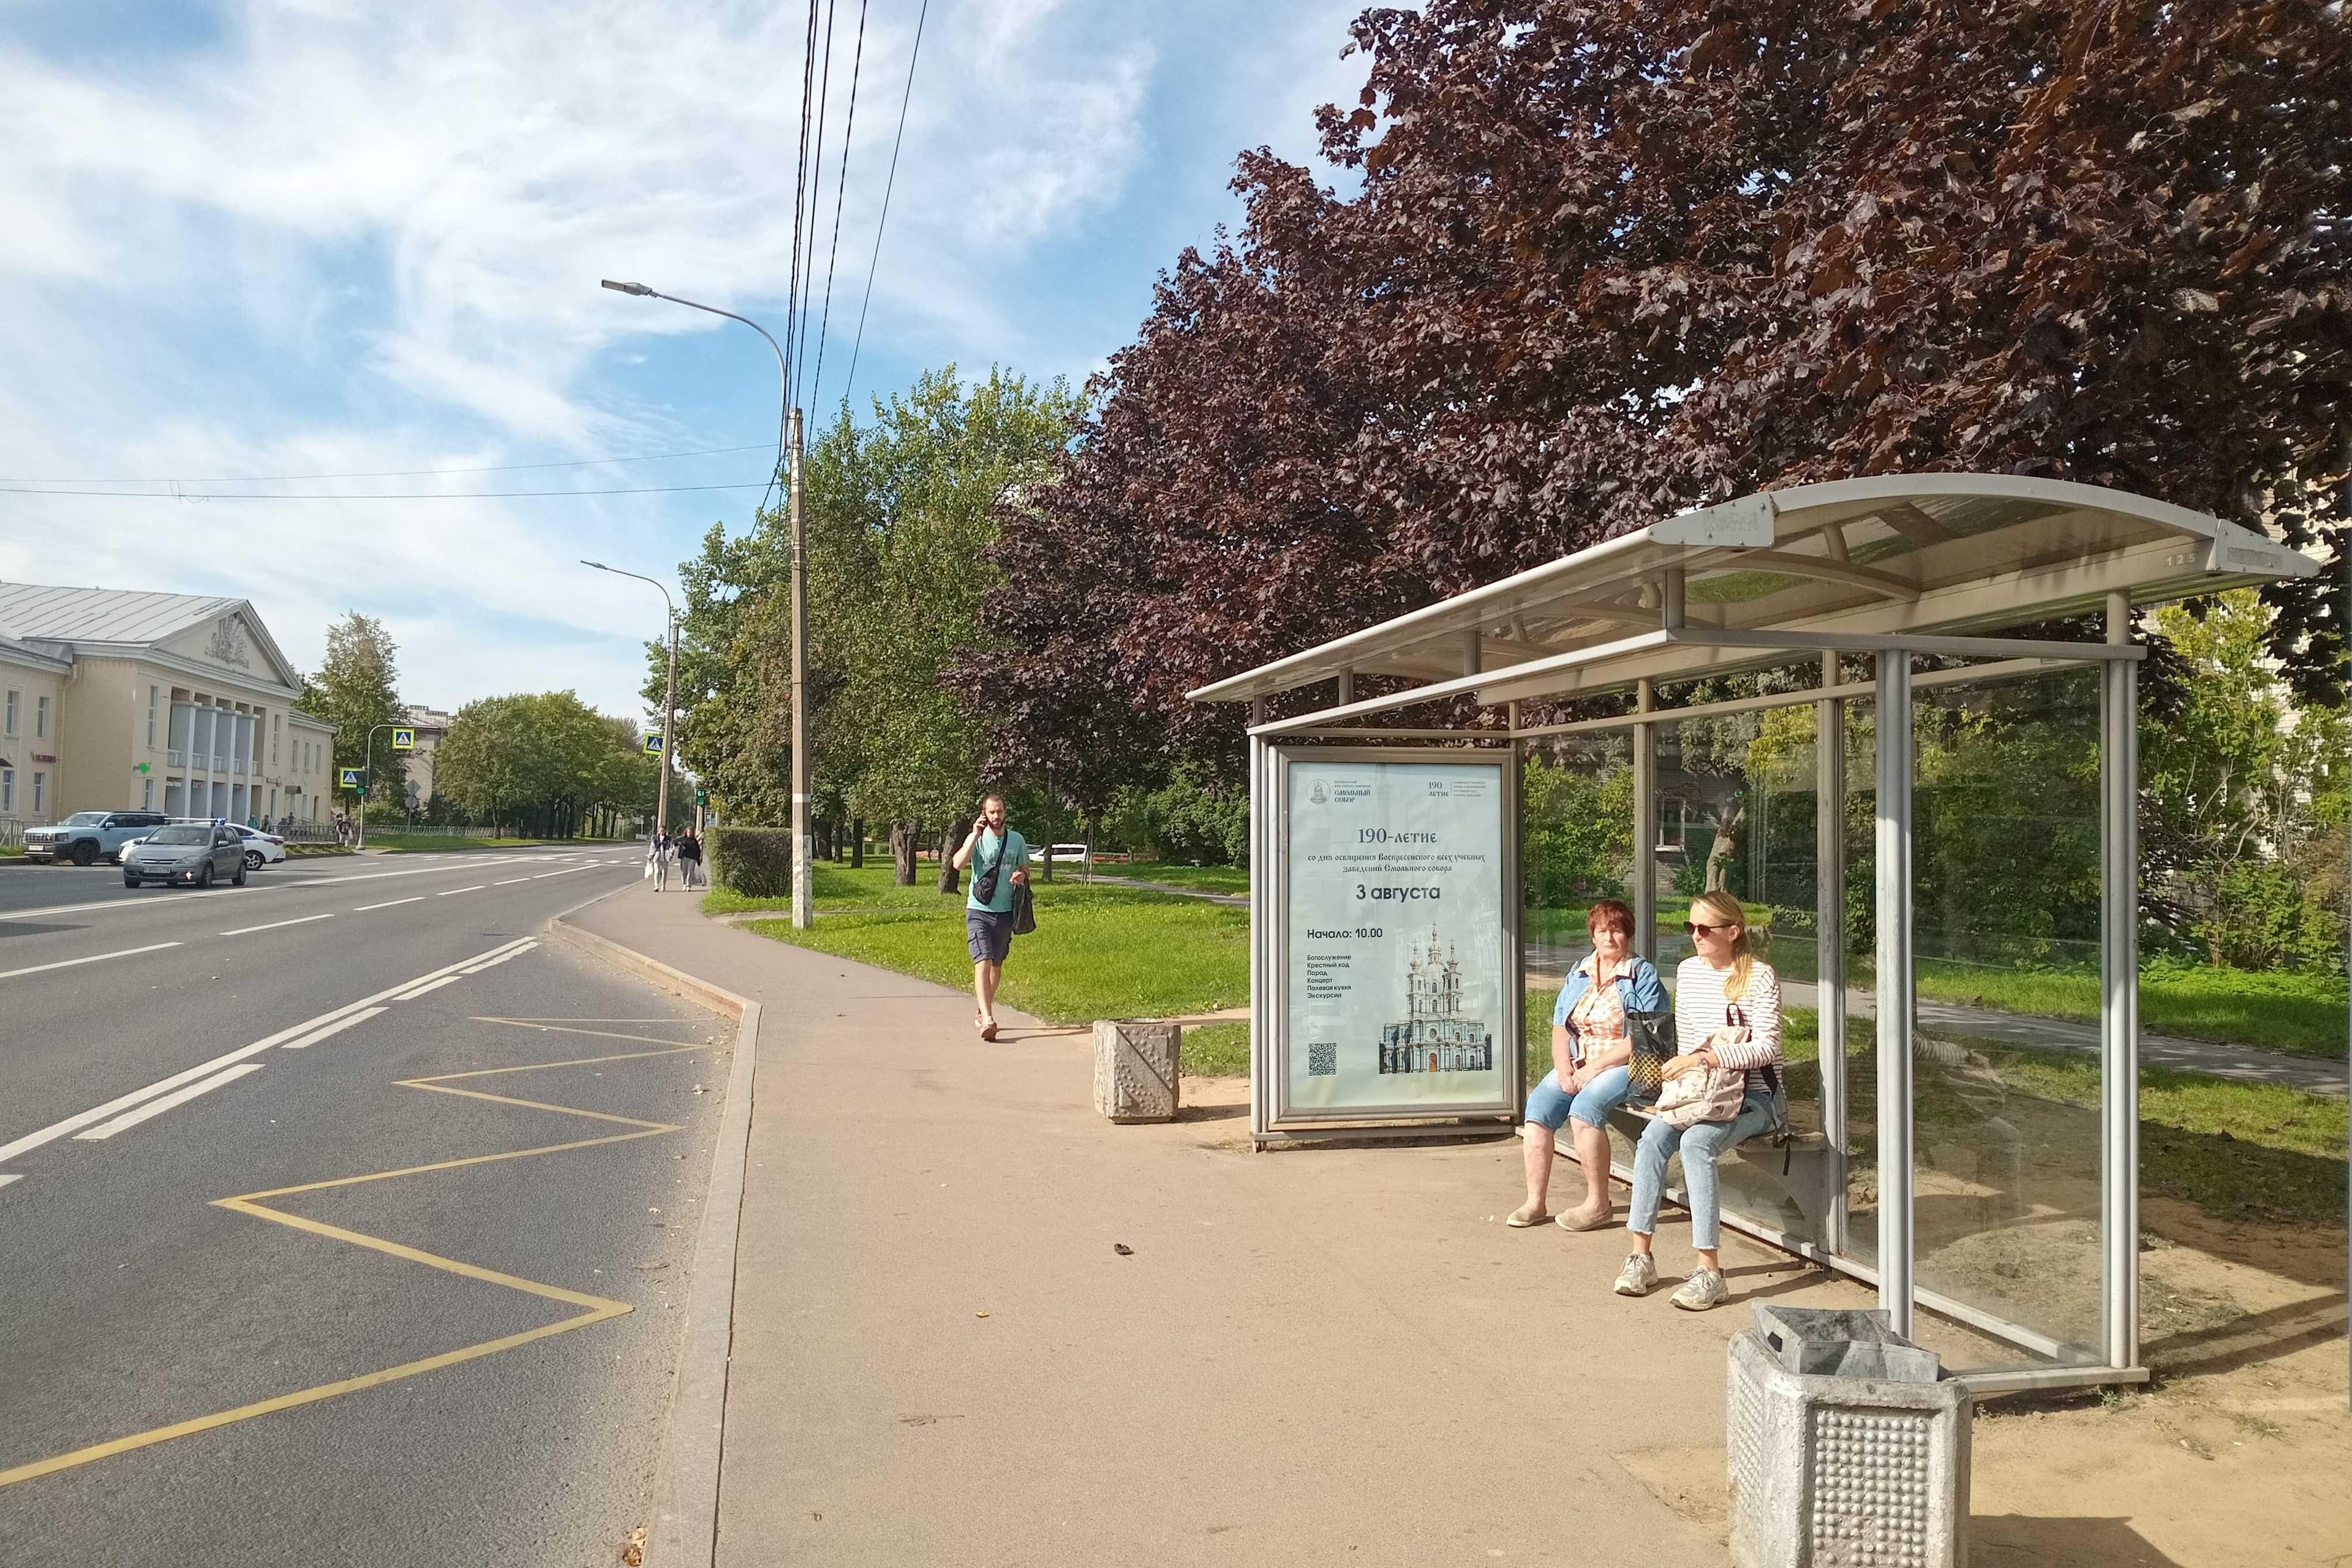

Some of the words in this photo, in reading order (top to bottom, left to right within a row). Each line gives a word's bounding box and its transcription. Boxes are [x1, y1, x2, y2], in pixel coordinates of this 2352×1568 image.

[2166, 553, 2196, 566] 125
[1359, 828, 1437, 843] 190-летие
[1379, 853, 1435, 862] Воскресенского
[1356, 884, 1366, 900] 3
[1371, 887, 1440, 903] августа
[1307, 929, 1352, 938] Начало:
[1355, 928, 1382, 938] 10.00
